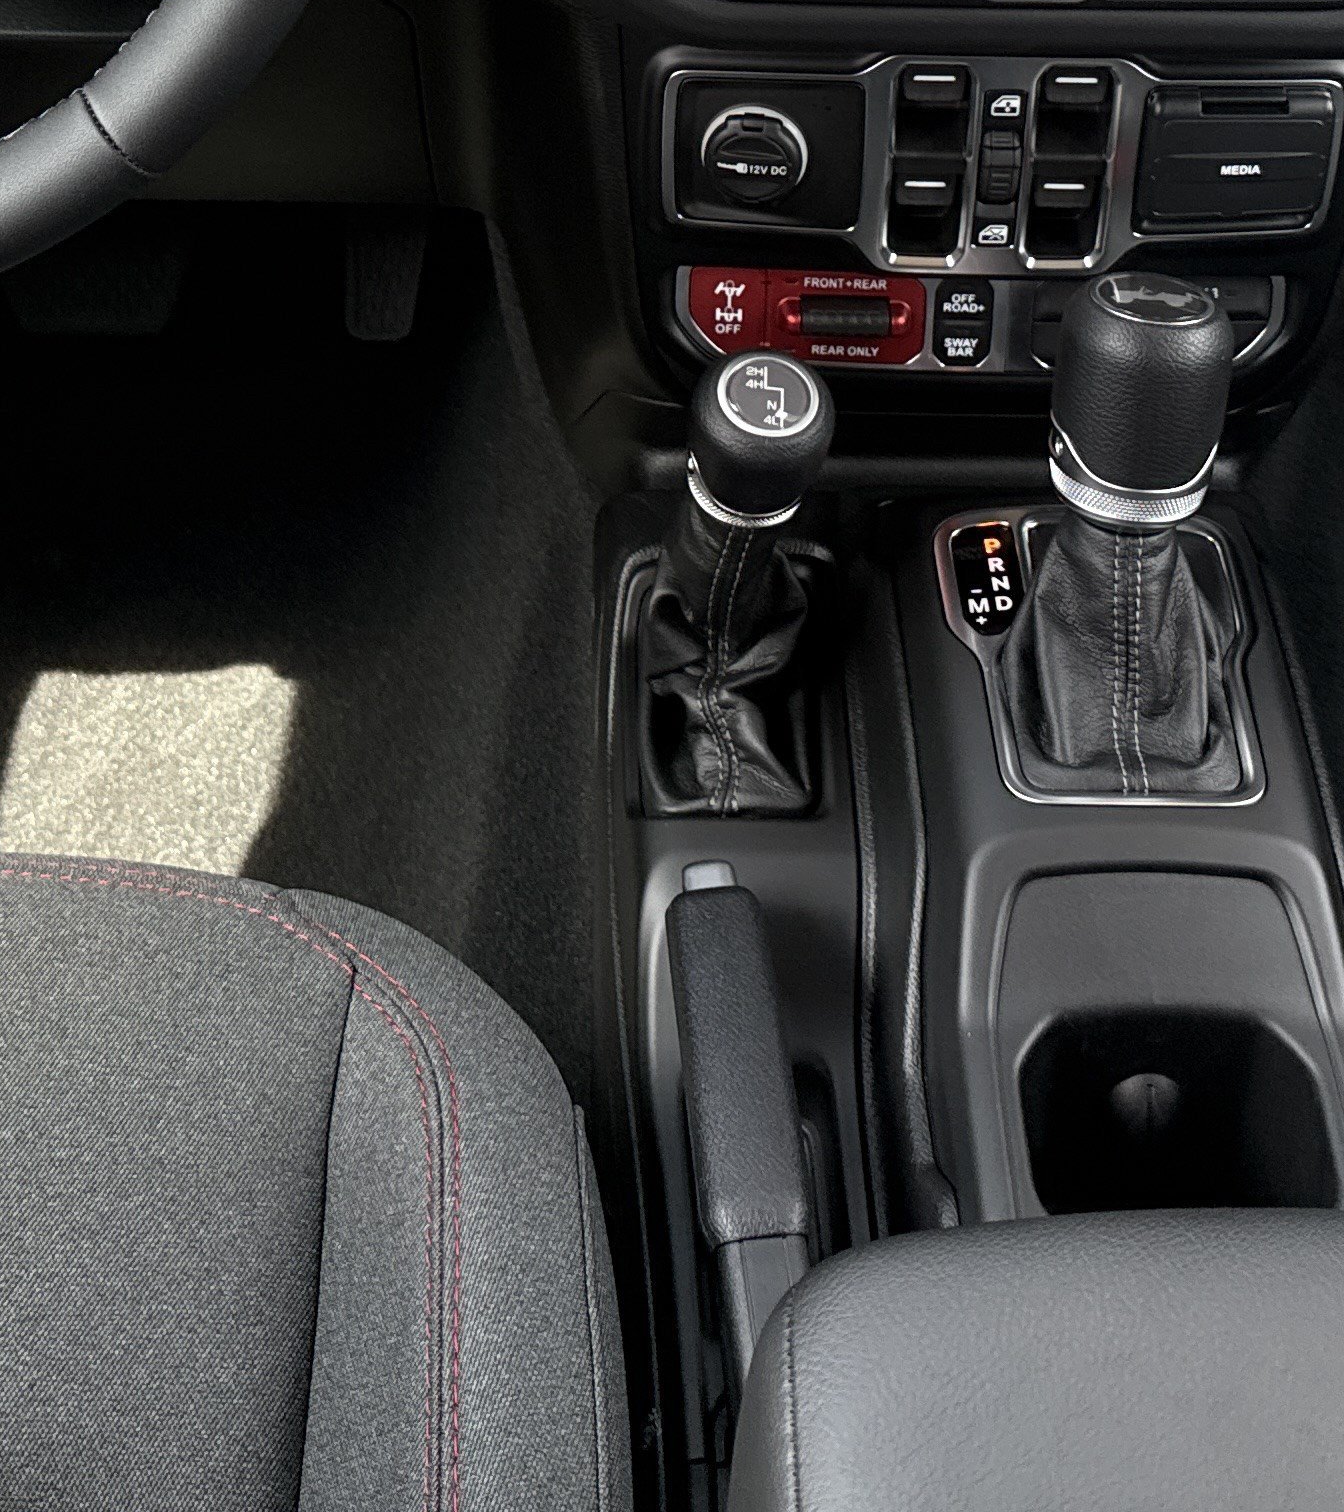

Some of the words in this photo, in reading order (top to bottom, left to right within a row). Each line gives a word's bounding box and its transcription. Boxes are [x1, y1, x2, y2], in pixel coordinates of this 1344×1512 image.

[749, 164, 768, 176] 12V
[771, 164, 788, 176] DC
[1220, 164, 1262, 177] MEDIA
[951, 293, 976, 304] OFF
[942, 302, 986, 313] ROAD+
[715, 323, 742, 334] OFF
[944, 337, 979, 348] SWAY
[811, 344, 845, 356] REAR
[847, 346, 879, 357] ONLY
[947, 347, 974, 357] BAR
[746, 366, 764, 377] 2H
[746, 379, 764, 389] 4H
[766, 400, 777, 411] N
[983, 538, 1002, 554] P
[987, 557, 1006, 572] R
[991, 575, 1011, 592] N
[967, 597, 990, 614] M
[995, 595, 1013, 611] D
